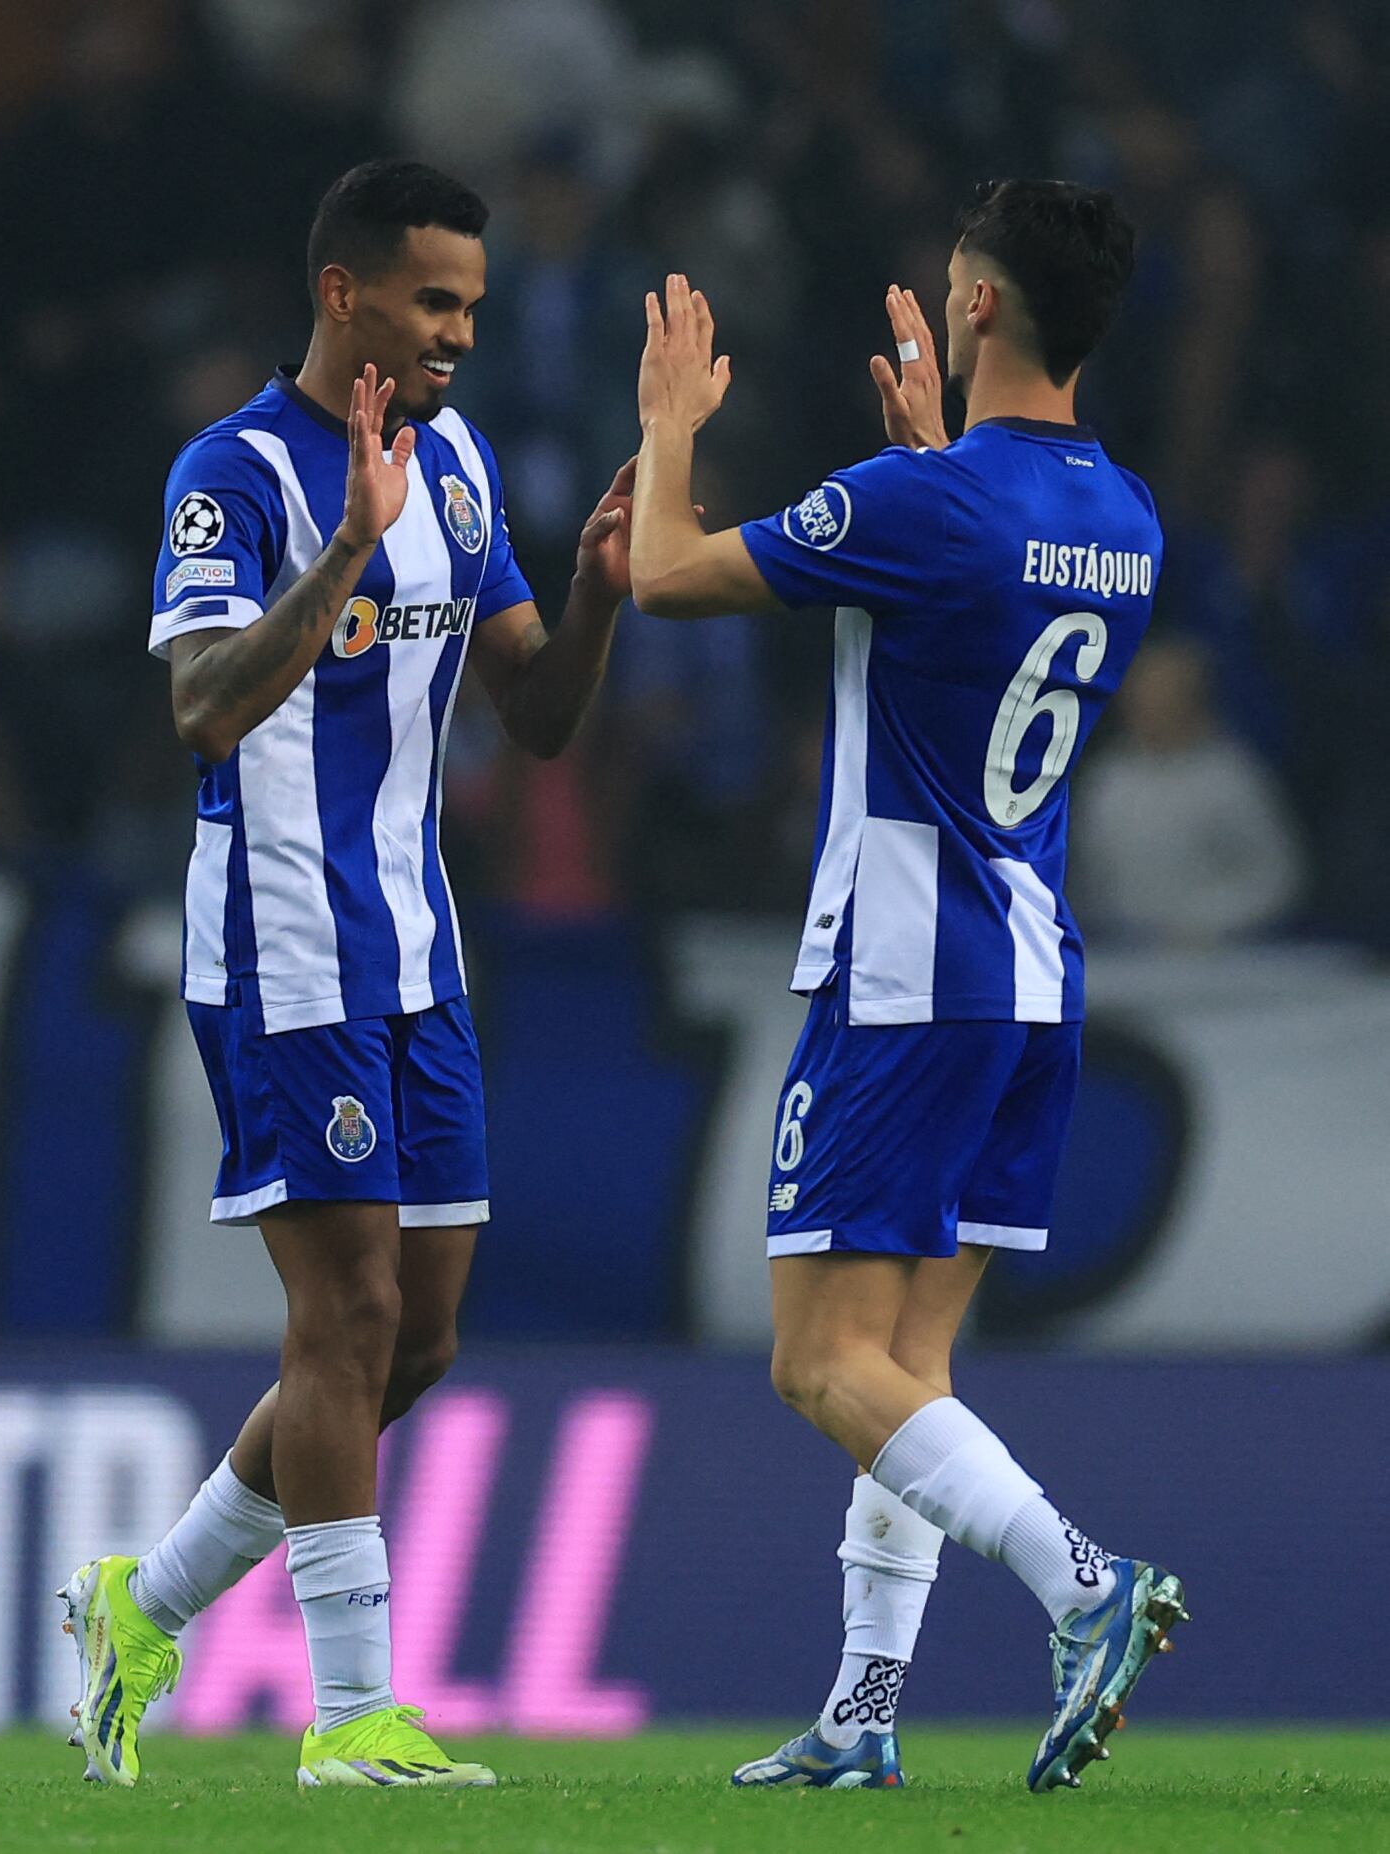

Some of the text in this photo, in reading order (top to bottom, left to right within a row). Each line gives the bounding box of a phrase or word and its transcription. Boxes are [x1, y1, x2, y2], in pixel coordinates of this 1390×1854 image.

[811, 488, 838, 537] SUPER
[1023, 540, 1151, 598] EUSTÁQUIO
[983, 612, 1108, 828] 6
[775, 1081, 812, 1172] 6
